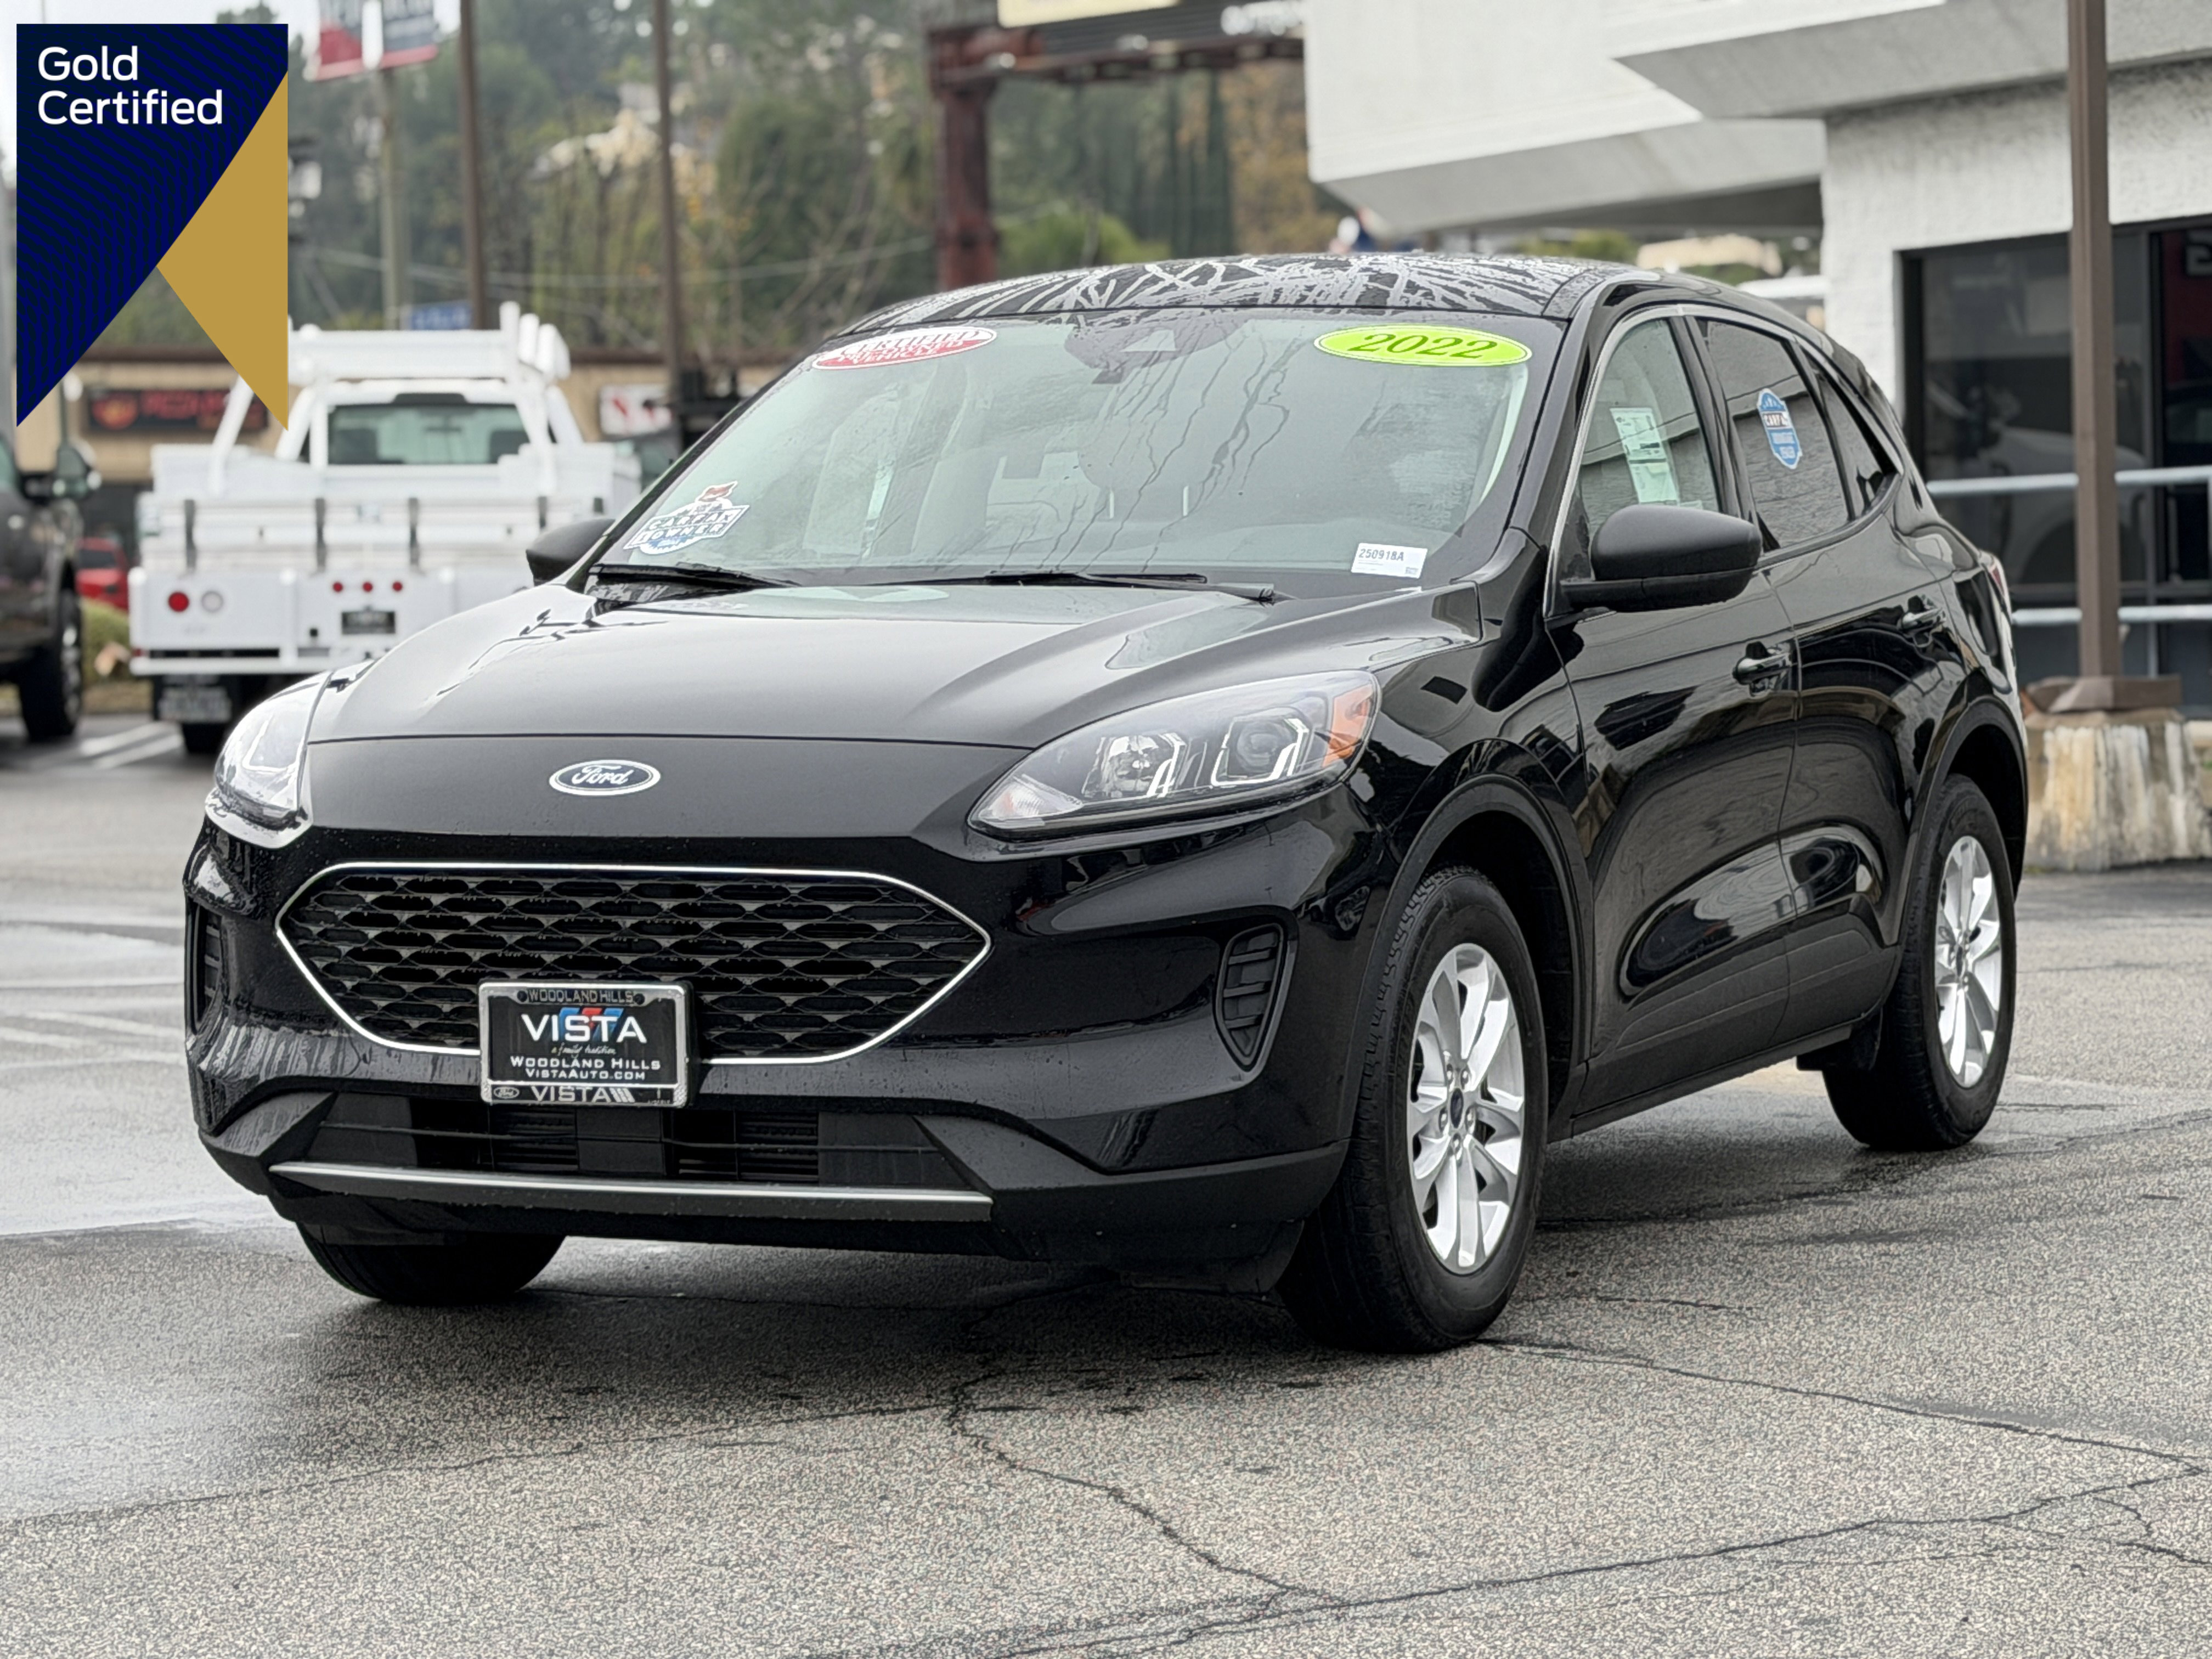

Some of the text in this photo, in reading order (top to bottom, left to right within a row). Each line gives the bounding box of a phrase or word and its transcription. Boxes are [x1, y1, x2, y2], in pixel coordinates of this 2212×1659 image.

[1347, 333, 1498, 358] 2022
[649, 512, 736, 530] CARFAX
[651, 523, 724, 540] OWNER
[1358, 549, 1404, 561] 250918A
[571, 765, 635, 785] Ford
[528, 989, 634, 1003] WOODLAND HILLS
[521, 1014, 647, 1043] VISTA
[531, 1086, 613, 1103] VISTA
